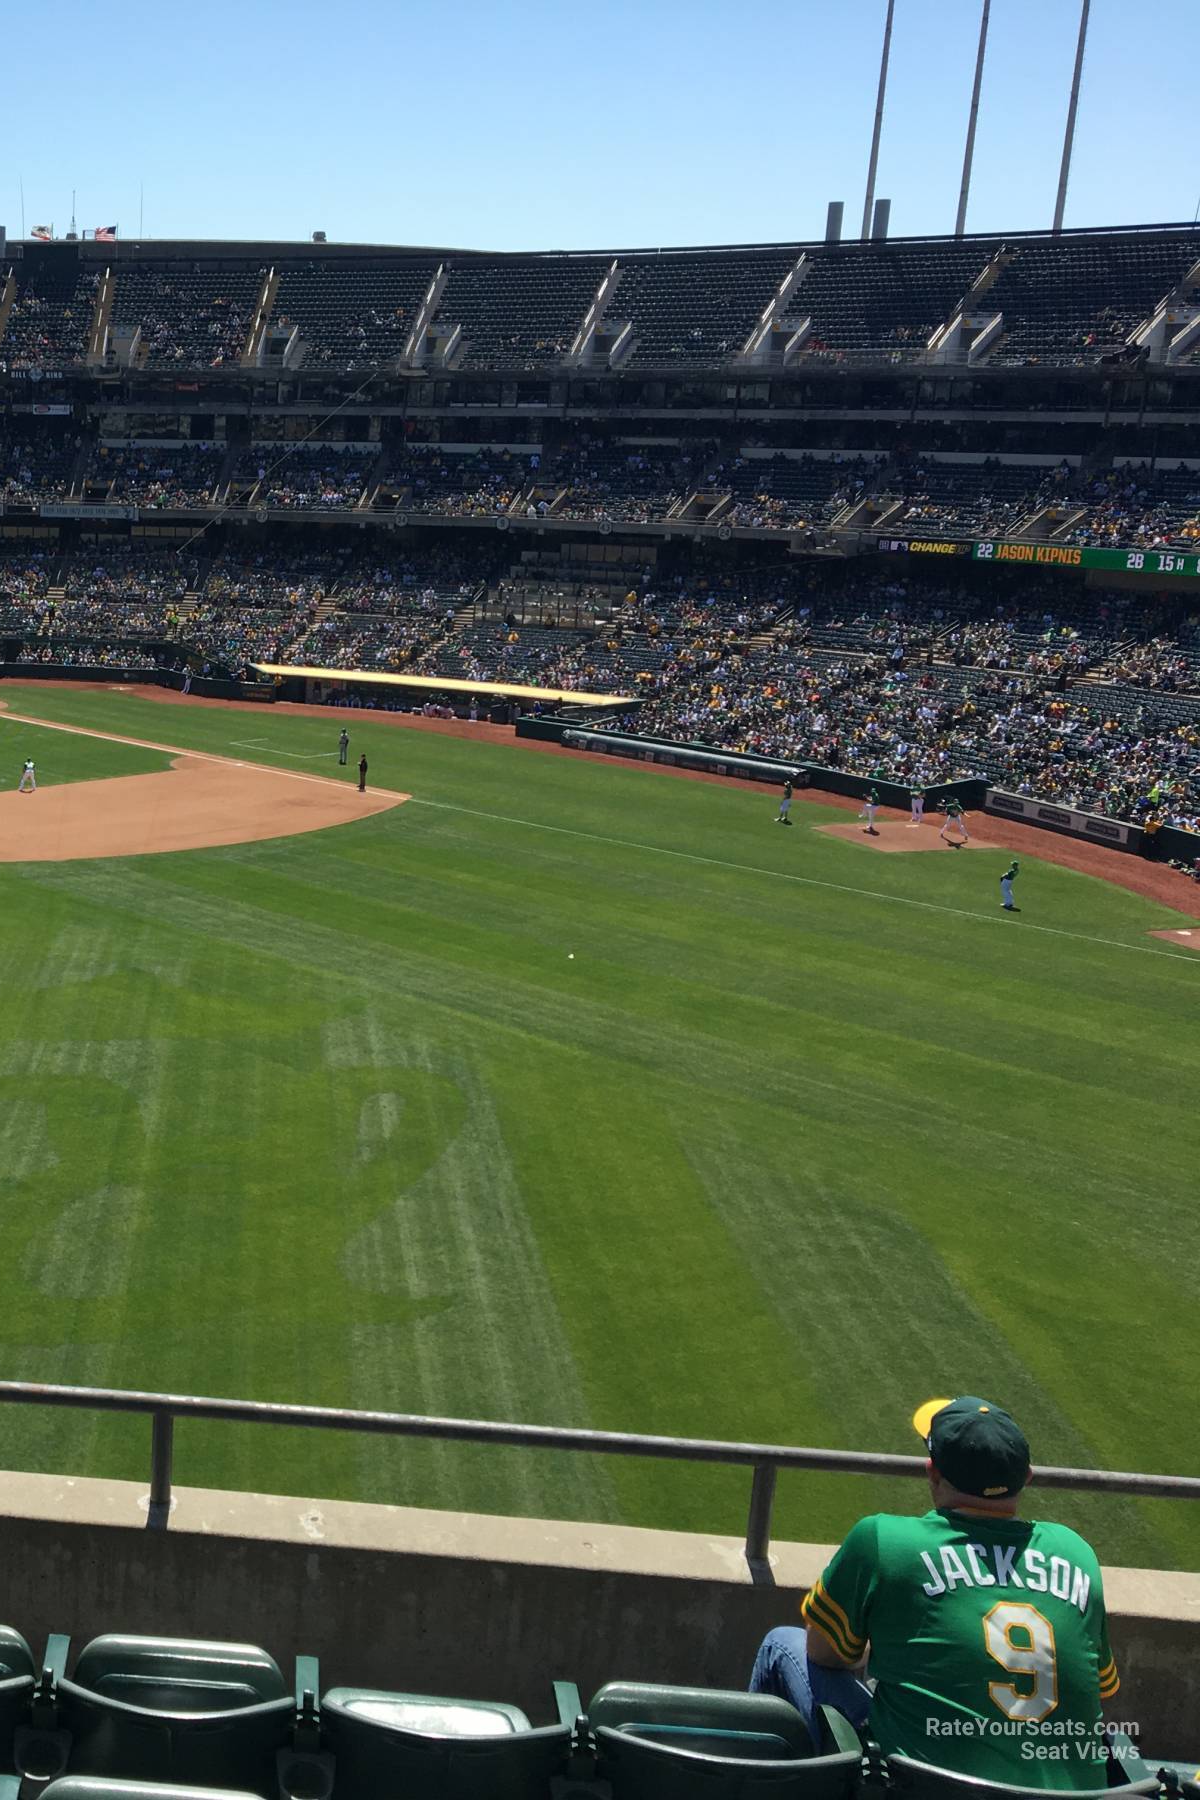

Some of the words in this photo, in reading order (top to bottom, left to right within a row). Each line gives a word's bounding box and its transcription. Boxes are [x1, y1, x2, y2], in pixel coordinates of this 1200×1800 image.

[977, 543, 993, 558] 22
[995, 544, 1033, 562] JASON
[1036, 548, 1082, 565] KIPNIS
[1126, 553, 1144, 569] 2B
[1158, 555, 1174, 571] 15
[920, 1543, 1090, 1614] JACKSON
[982, 1600, 1059, 1722] 9
